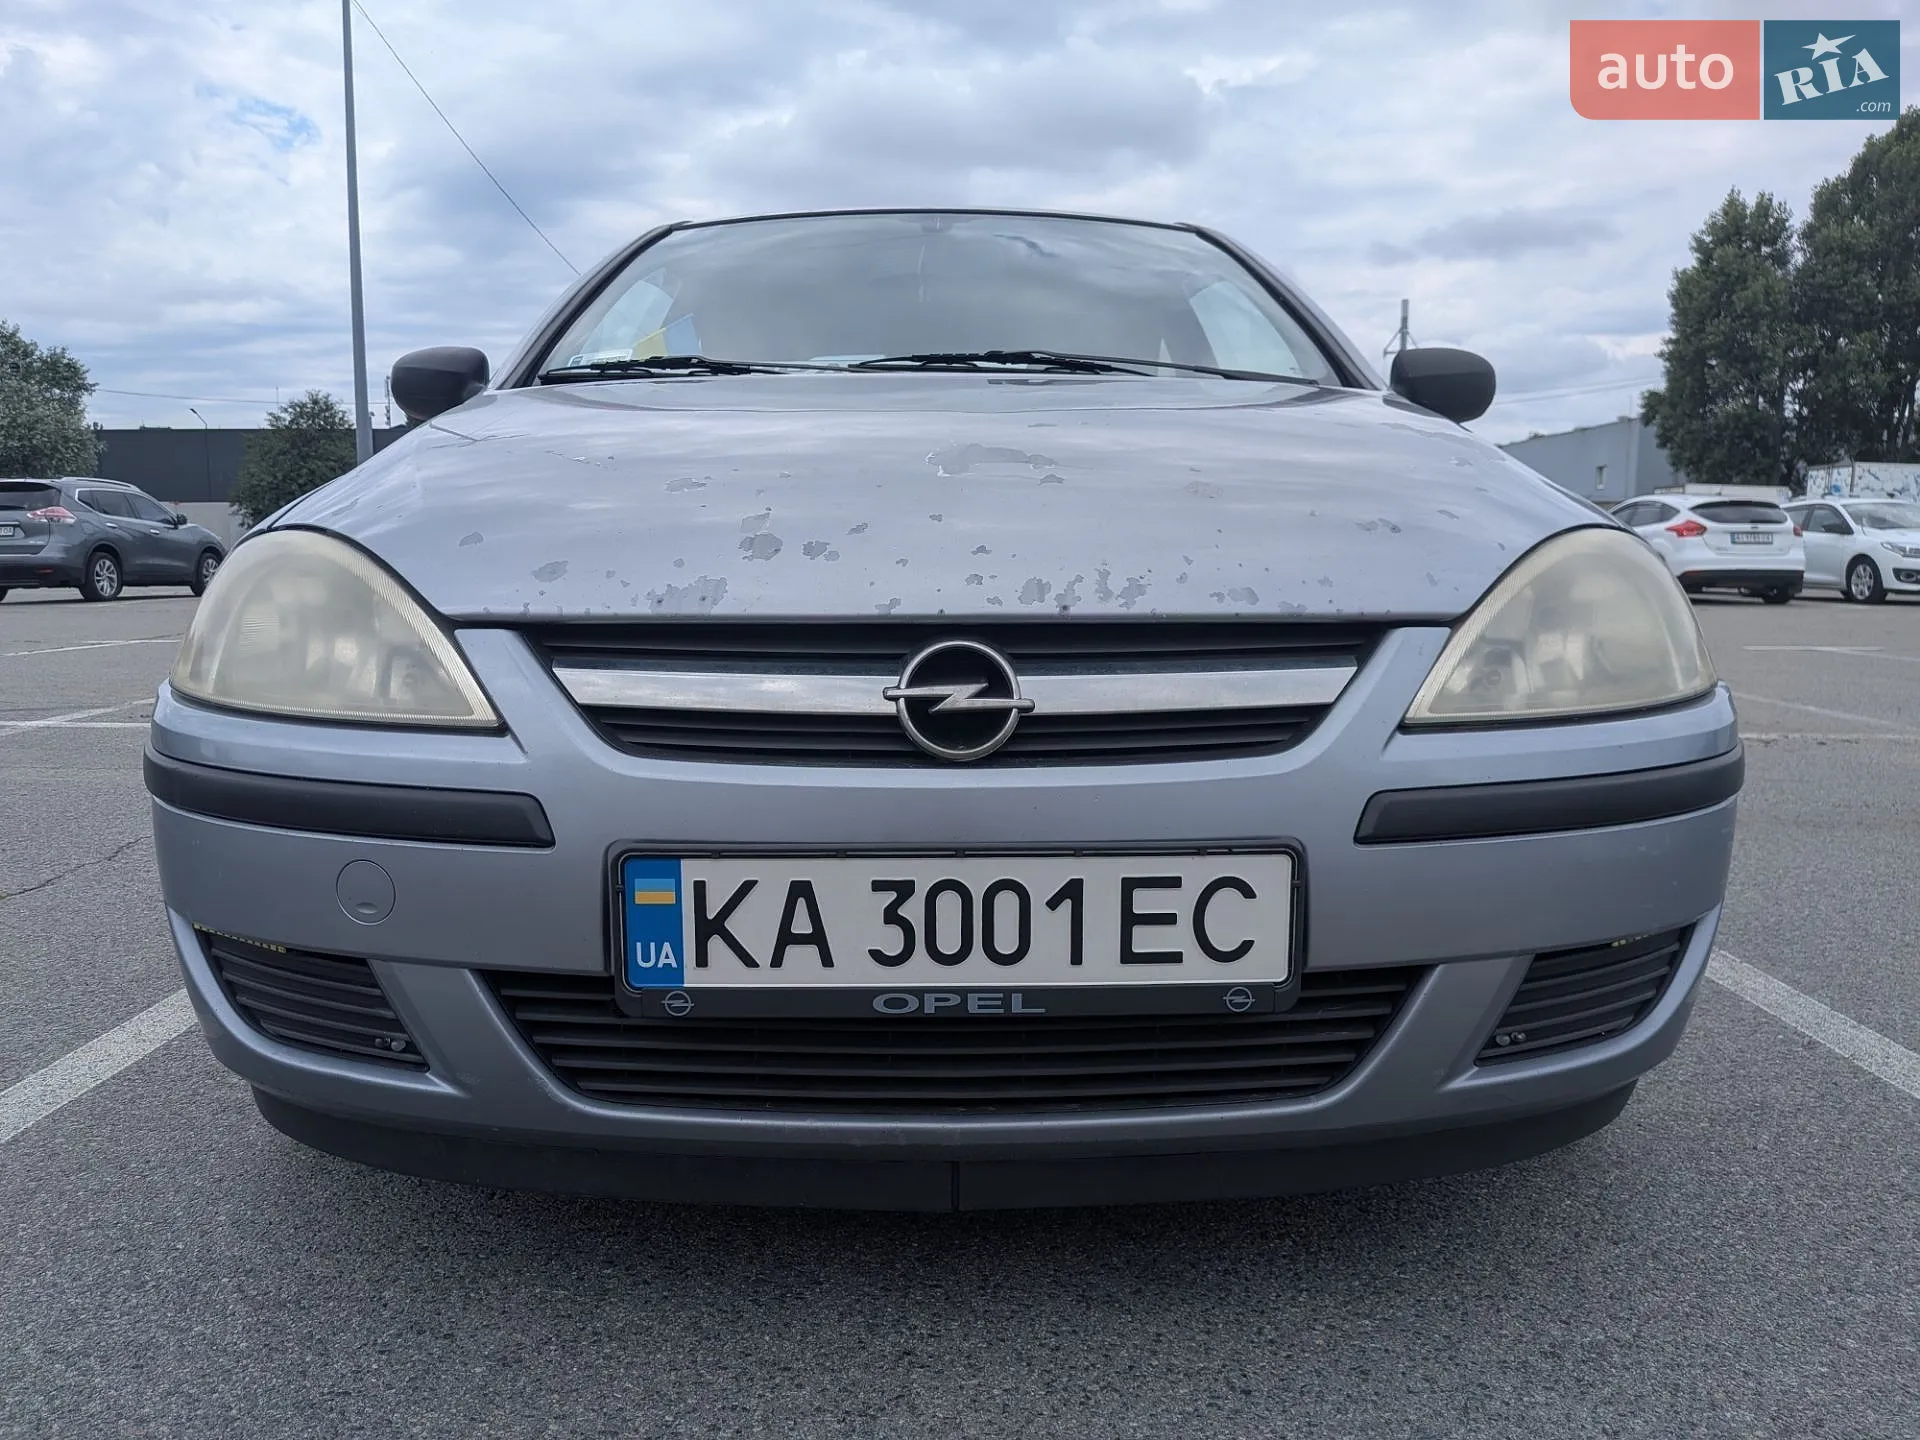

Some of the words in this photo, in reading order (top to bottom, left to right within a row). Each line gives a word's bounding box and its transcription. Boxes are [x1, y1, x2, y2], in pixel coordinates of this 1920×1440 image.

[692, 878, 835, 969] KA
[867, 878, 1084, 967] 3001
[1119, 876, 1257, 965] EC
[635, 941, 678, 968] UA
[872, 992, 1046, 1014] OPEL
